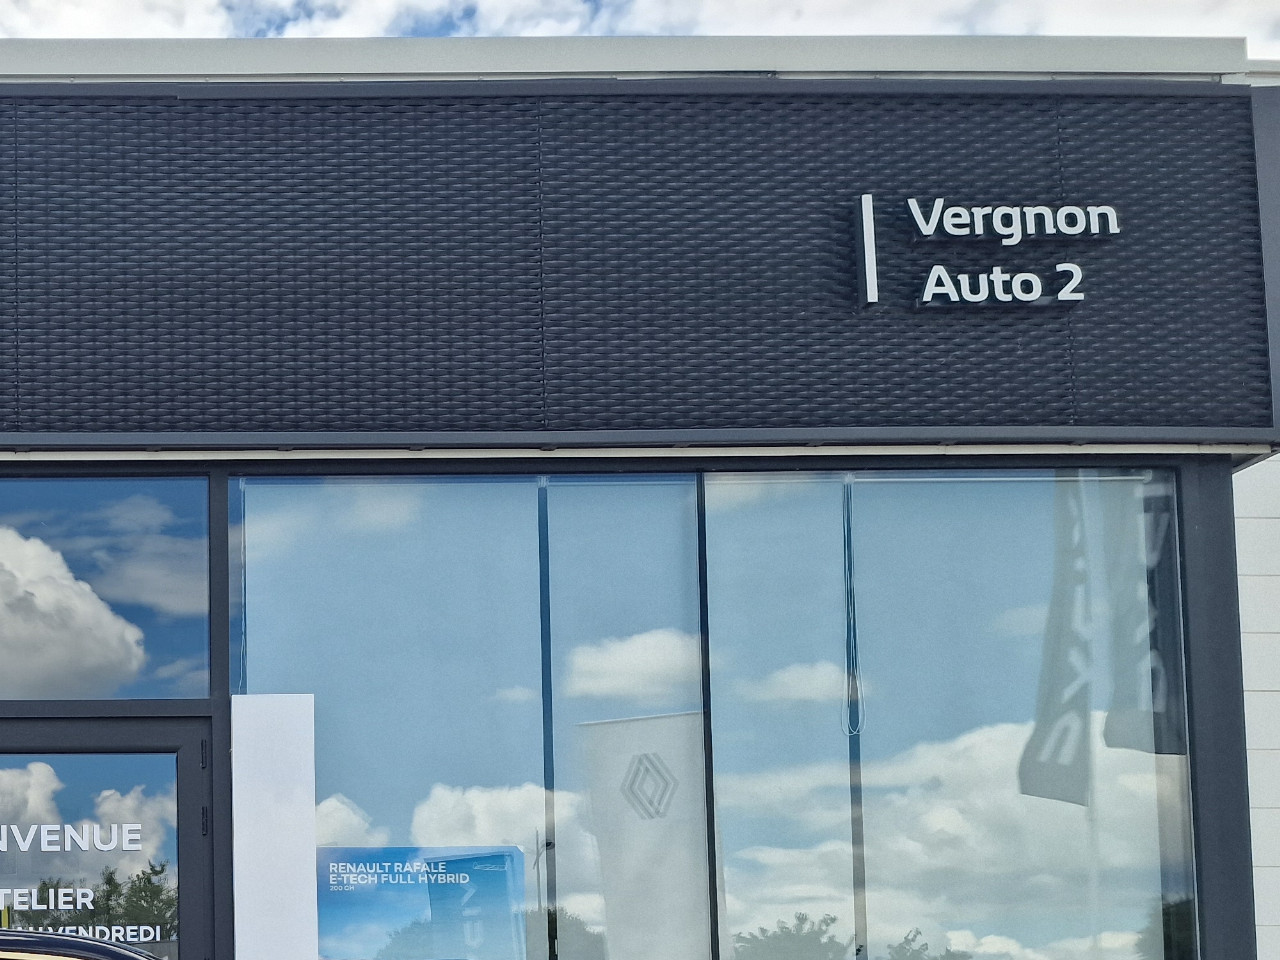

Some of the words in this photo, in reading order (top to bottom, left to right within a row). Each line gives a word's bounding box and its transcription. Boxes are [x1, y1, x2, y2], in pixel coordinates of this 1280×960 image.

[907, 198, 1120, 246] Vergnon
[923, 265, 1042, 302] Auto
[1056, 263, 1084, 301] 2
[329, 862, 391, 873] RENAULT
[394, 862, 447, 873] RAFALE
[329, 874, 378, 884] E-TECH
[381, 874, 415, 884] FULL
[418, 873, 470, 884] HYBRID
